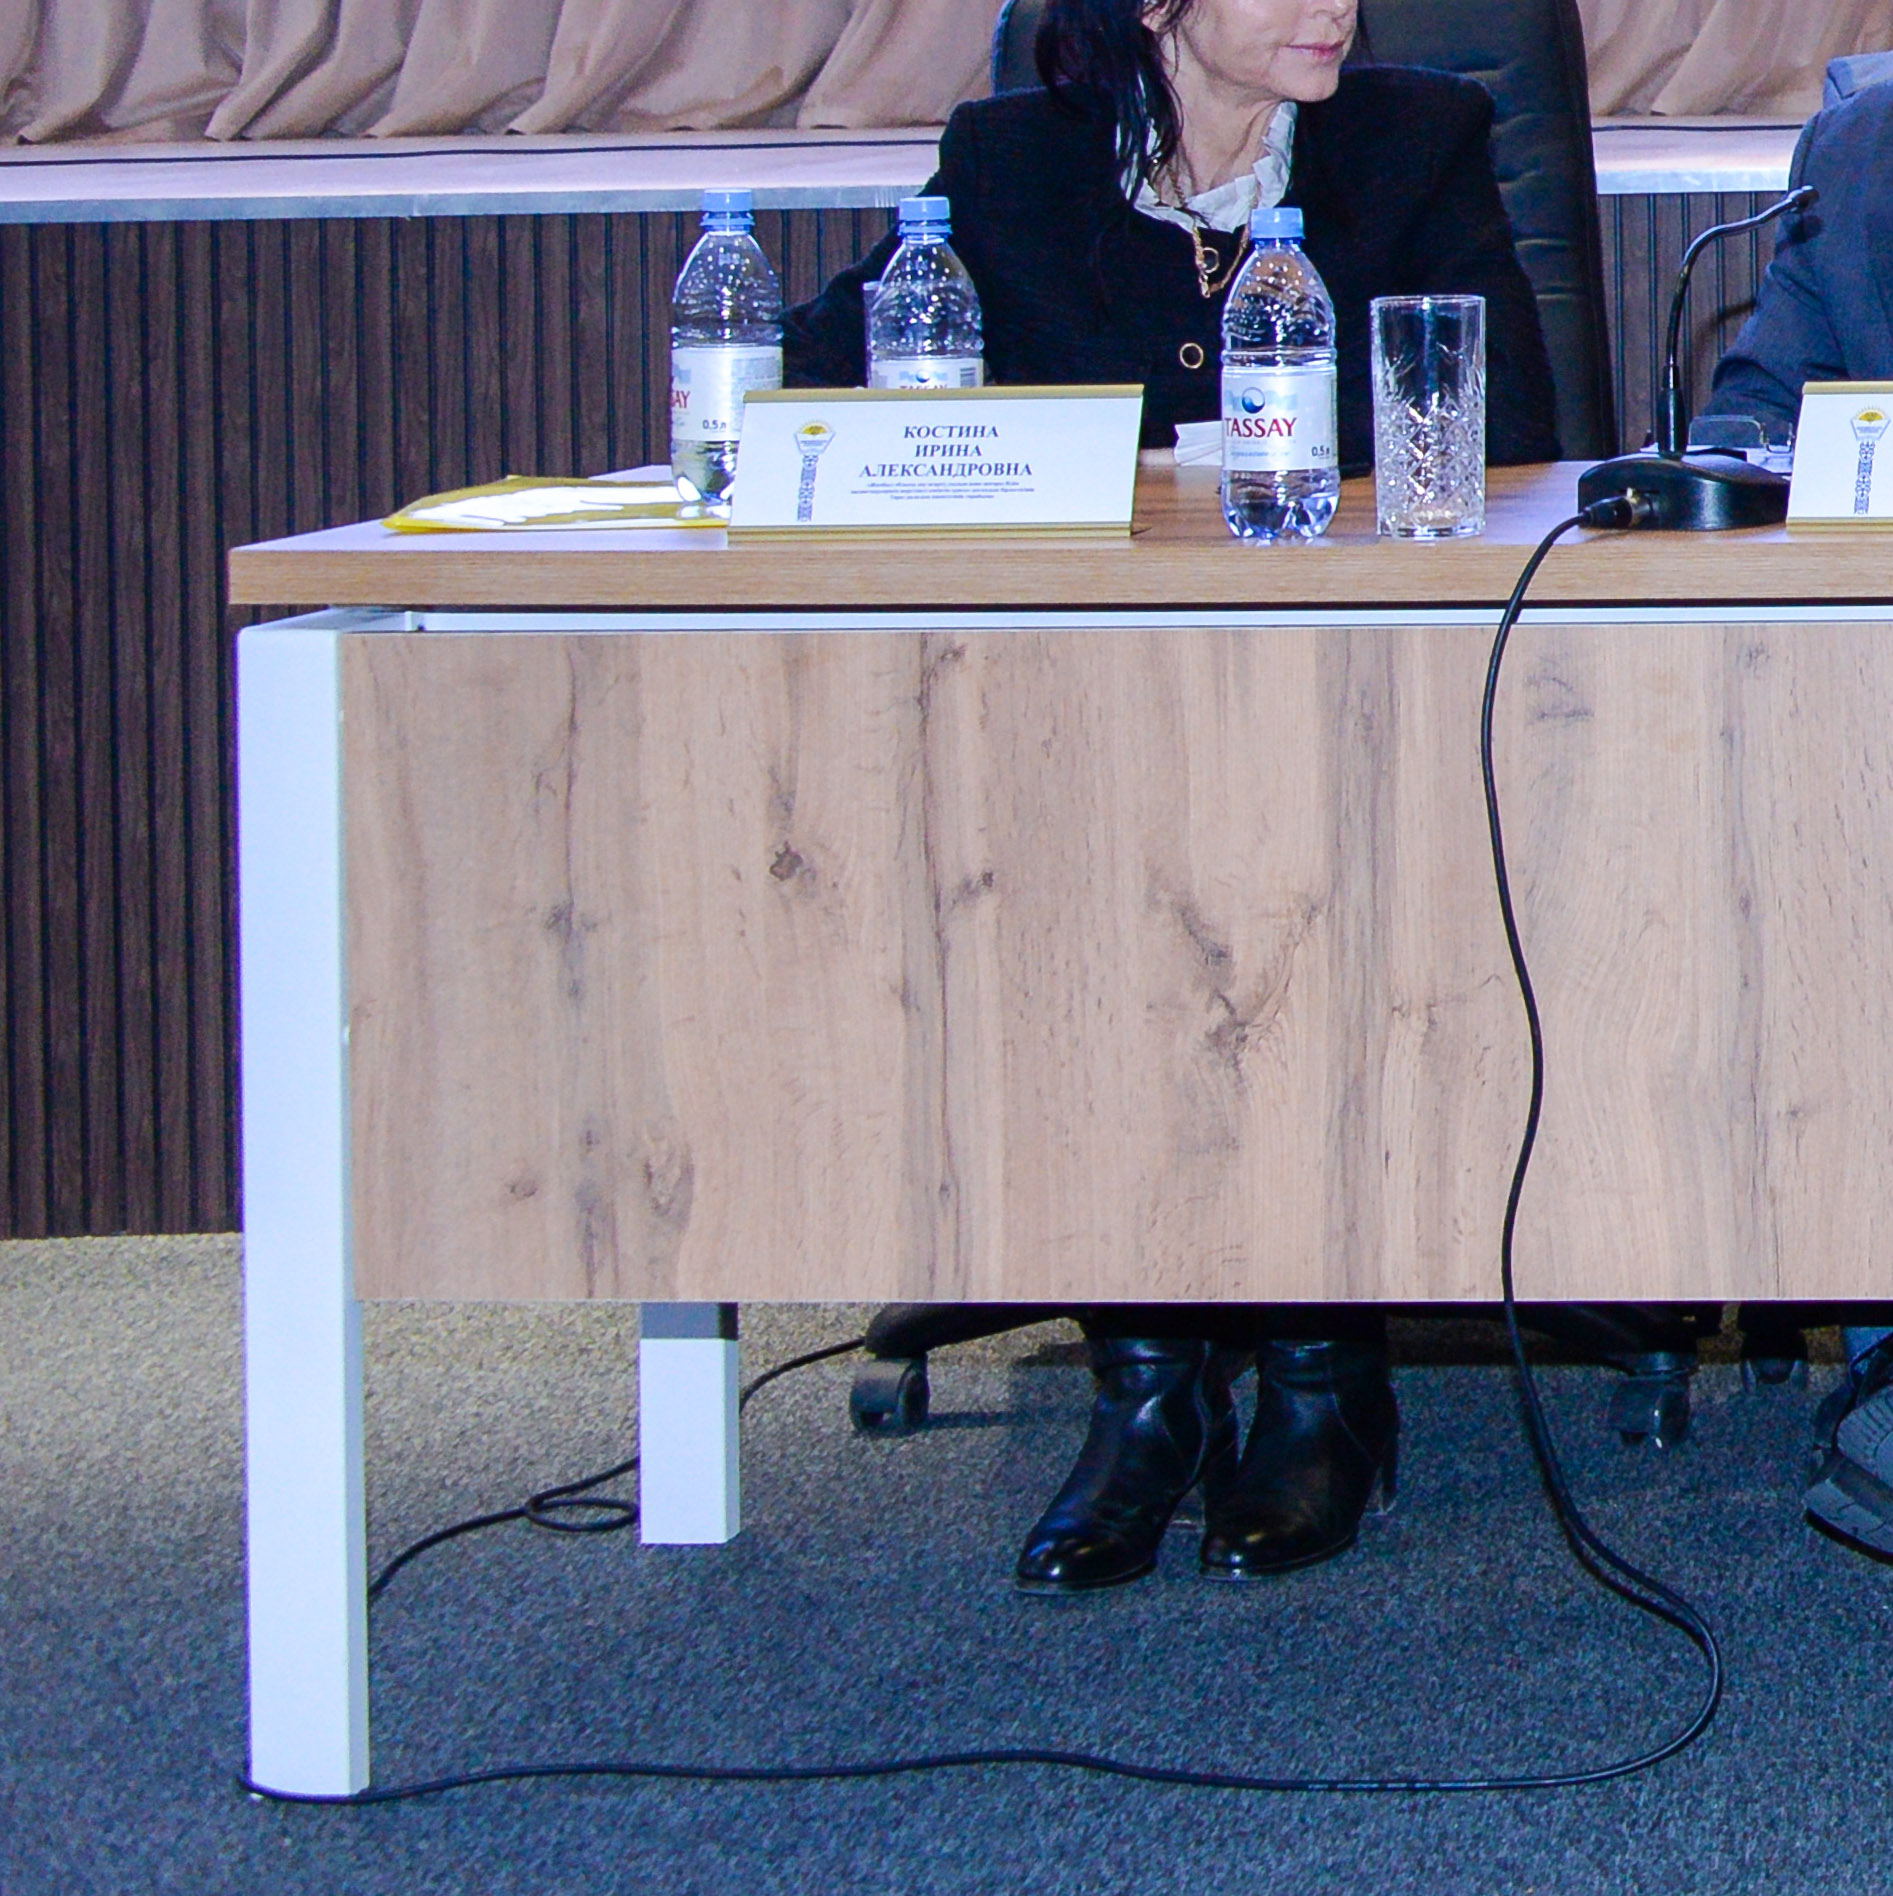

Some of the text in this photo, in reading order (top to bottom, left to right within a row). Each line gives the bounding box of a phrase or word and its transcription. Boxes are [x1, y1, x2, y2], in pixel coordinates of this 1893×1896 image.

[903, 425, 999, 439] КОСТИНА
[1225, 417, 1297, 438] TASSAY
[914, 444, 982, 458] ИРИНА
[859, 462, 1033, 478] АЛЕКСАНДРОВНА
